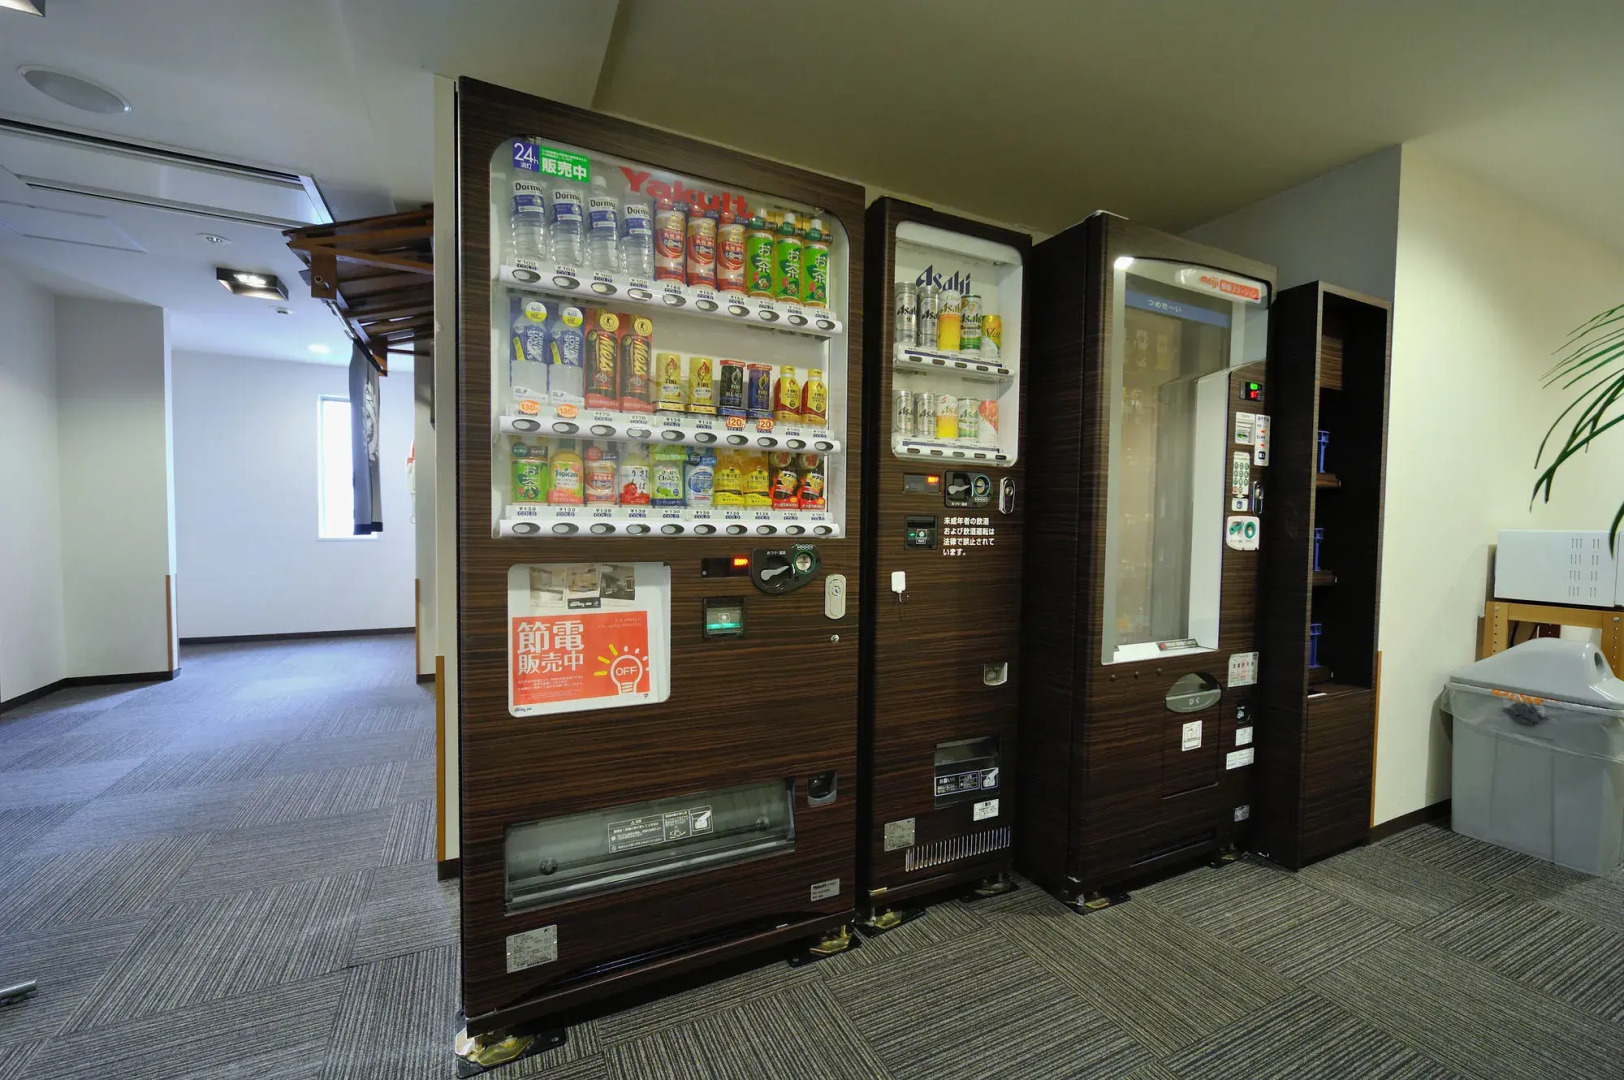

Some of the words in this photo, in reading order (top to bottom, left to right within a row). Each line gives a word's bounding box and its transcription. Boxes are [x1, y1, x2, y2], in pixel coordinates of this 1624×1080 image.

[513, 142, 539, 166] 24h
[541, 157, 587, 180] 販売中
[515, 182, 543, 195] Dormy
[555, 191, 582, 204] Dormy
[619, 165, 756, 219] Yakult
[590, 199, 616, 210] Dormy
[756, 243, 772, 273] お茶
[785, 249, 800, 279] お茶
[812, 254, 826, 284] お茶
[915, 264, 971, 296] Asahi
[522, 464, 538, 490] お茶
[943, 516, 990, 526] 未成年者の飲酒
[943, 527, 995, 536] および飲酒運転は
[943, 537, 995, 546] 法律で禁止されて
[517, 620, 585, 654] 節電
[518, 651, 584, 675] 販売中
[615, 665, 638, 676] OFF
